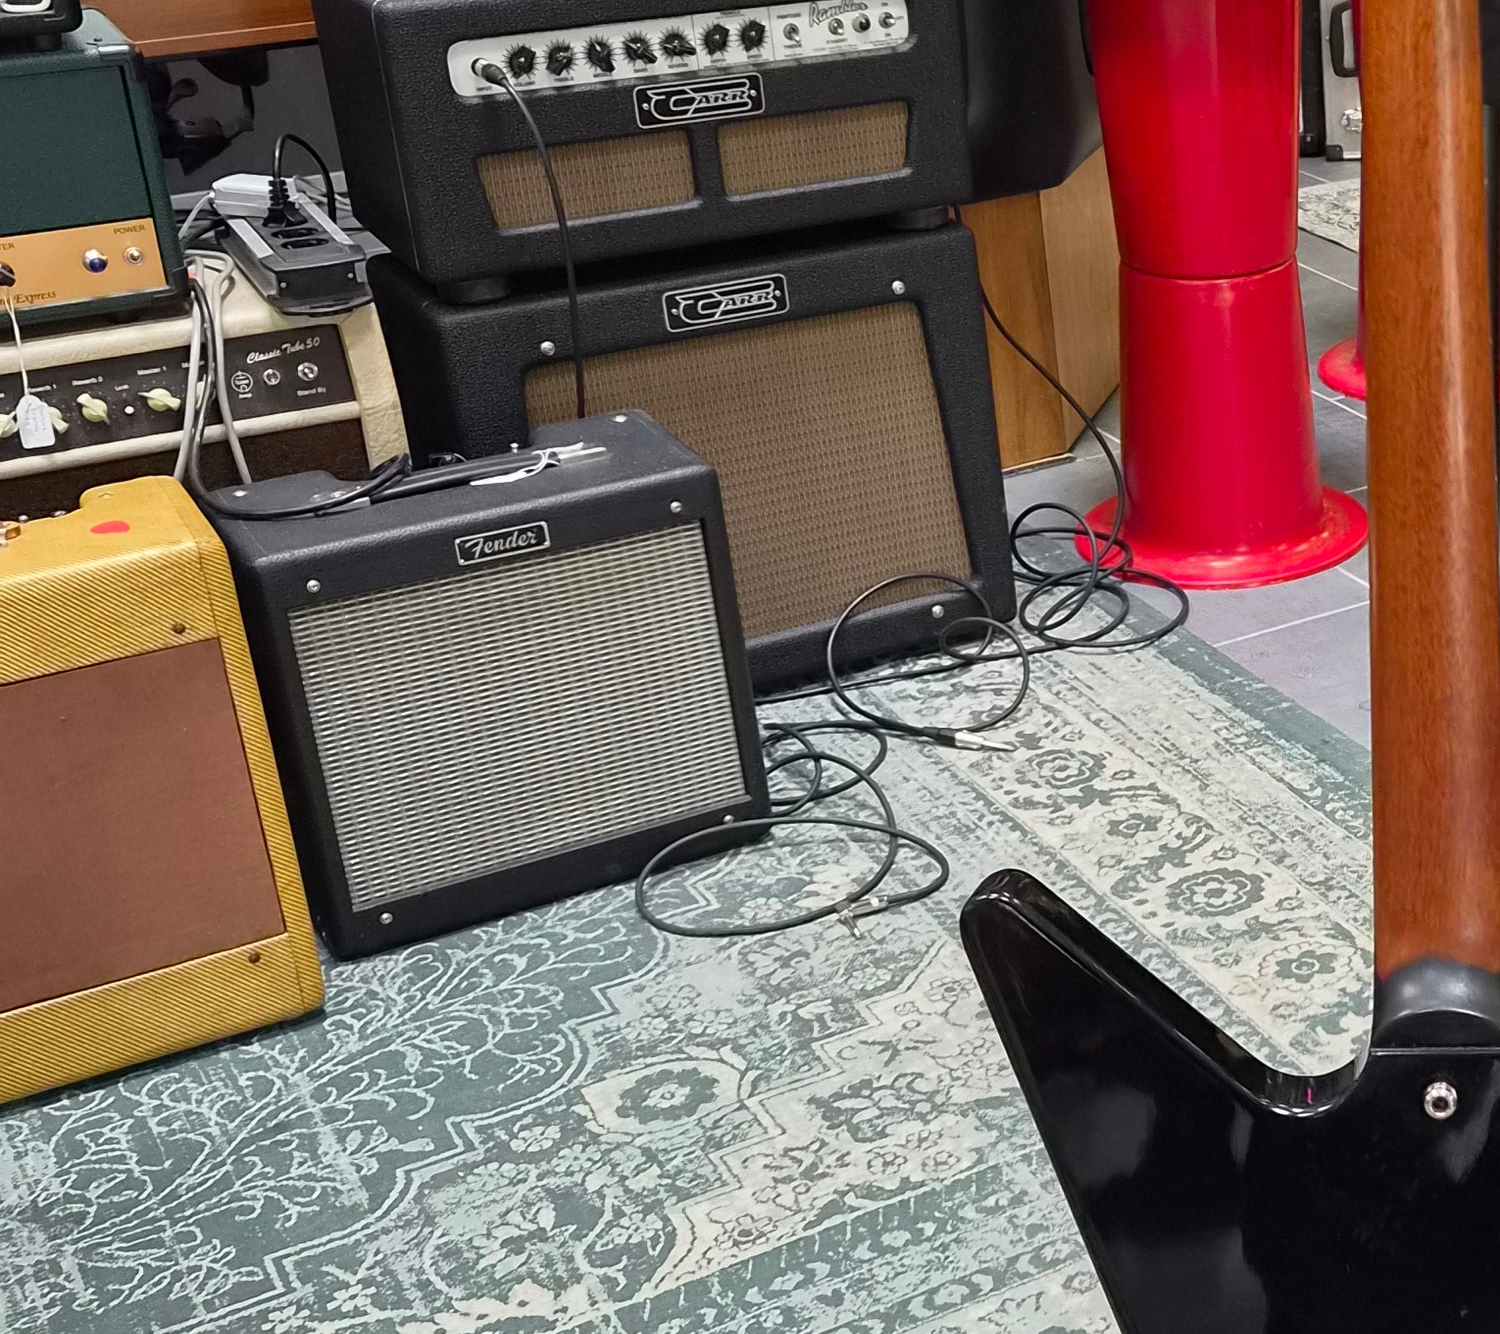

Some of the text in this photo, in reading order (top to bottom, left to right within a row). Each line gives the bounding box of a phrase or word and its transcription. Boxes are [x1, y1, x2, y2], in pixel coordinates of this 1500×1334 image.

[646, 78, 752, 120] CARR
[113, 225, 146, 235] POWER
[13, 291, 56, 305] Express
[675, 280, 777, 324] CARR
[246, 336, 320, 364] Classic Tube 50
[465, 531, 537, 559] Fender
